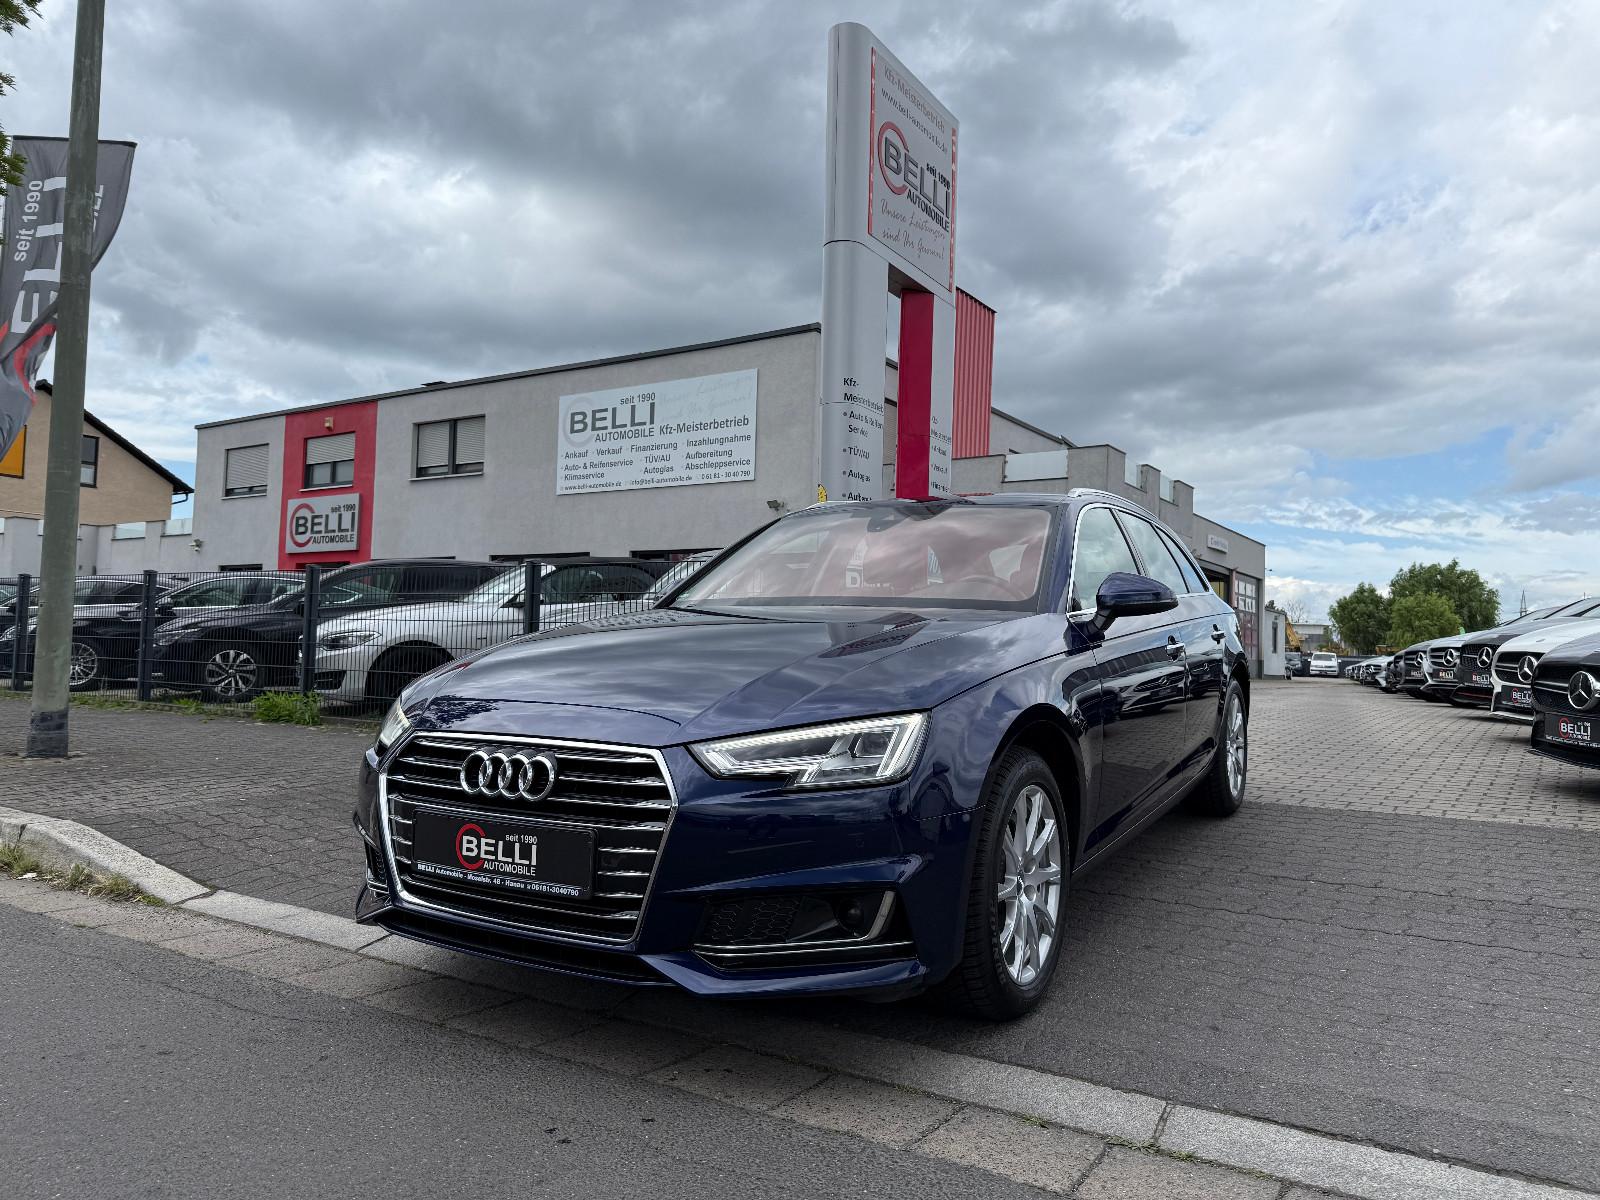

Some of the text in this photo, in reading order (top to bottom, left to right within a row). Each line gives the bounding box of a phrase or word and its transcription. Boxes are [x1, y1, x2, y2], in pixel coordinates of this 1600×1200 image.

[926, 162, 937, 178] seit
[885, 137, 950, 219] BELLI
[907, 189, 949, 233] AUTOMOBILE
[14, 180, 42, 261] seit 1990
[843, 377, 859, 387] Kfz-
[620, 392, 656, 406] seit 1990
[569, 402, 655, 434] BELLI
[659, 415, 750, 436] Kfz-Meisterbetrieb
[594, 427, 655, 443] AUTOMOBILE
[564, 433, 752, 460] Ankauf Verkauf Finanzierung Inzahlungnahme
[644, 454, 671, 464] TÜV/AU
[685, 449, 733, 460] Aufbereitung
[583, 462, 588, 470] &
[589, 459, 634, 470] Reifenservice
[643, 465, 674, 475] Autoglas
[685, 458, 751, 471] Abschleppservice
[564, 472, 605, 481] Klimaservice
[331, 503, 356, 513] seit 1990
[295, 512, 356, 536] BELLI
[312, 534, 354, 544] AUTOMOBILE
[1512, 691, 1531, 701] BELL
[1560, 722, 1590, 737] BELLI
[505, 834, 537, 844] seit 1990
[461, 835, 537, 866] BELLI
[417, 863, 435, 873] BELLI
[435, 867, 464, 878] Automobile
[483, 860, 537, 876] AUTOMOBILE
